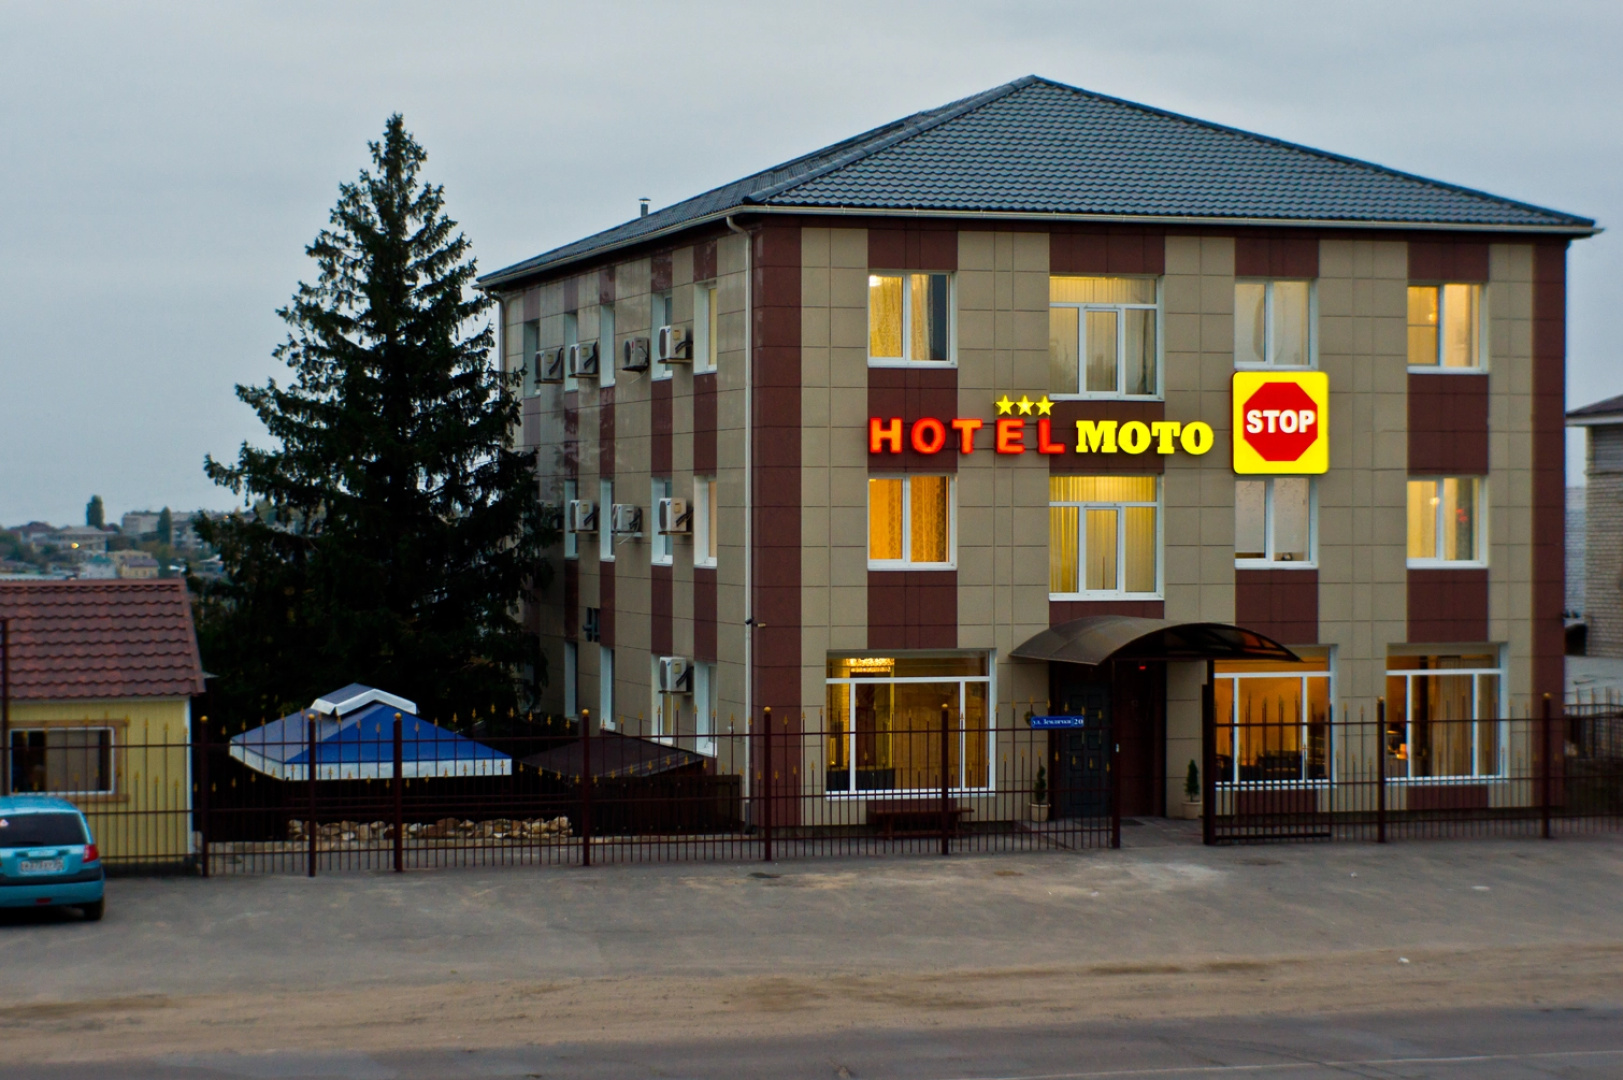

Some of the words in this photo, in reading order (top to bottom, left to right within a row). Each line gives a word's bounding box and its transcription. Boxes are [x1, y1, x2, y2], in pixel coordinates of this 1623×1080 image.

[868, 418, 1066, 455] HOTEL
[1075, 420, 1214, 456] MOTO
[1246, 409, 1316, 434] STOP
